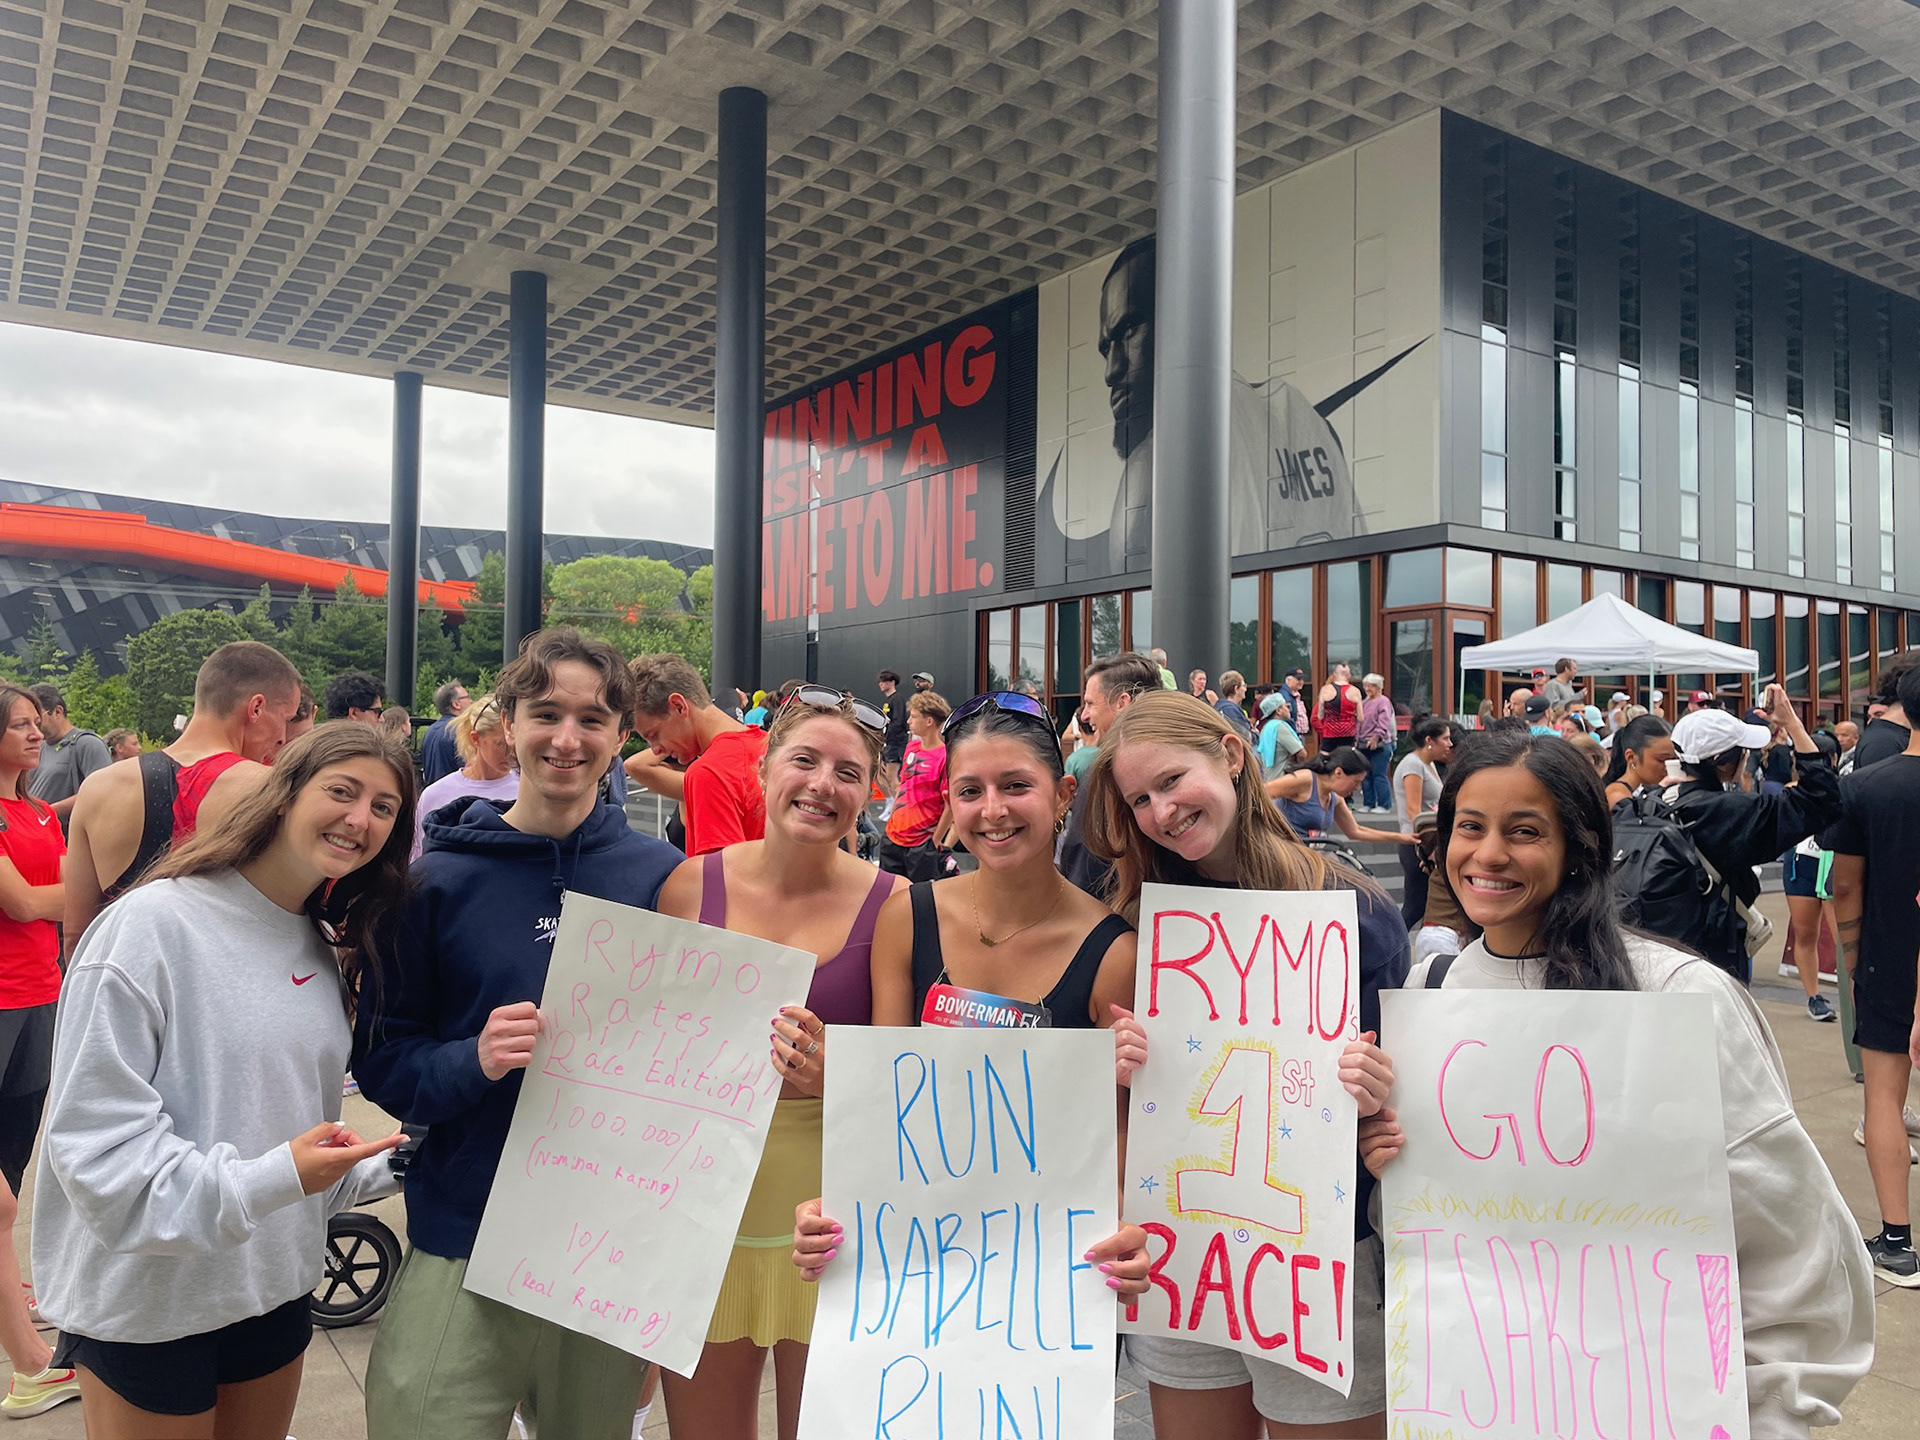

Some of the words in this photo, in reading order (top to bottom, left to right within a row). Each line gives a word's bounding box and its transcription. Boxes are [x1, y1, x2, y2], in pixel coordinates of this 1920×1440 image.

[900, 423, 949, 477] A
[841, 489, 894, 610] TO
[901, 463, 995, 600] ME.
[571, 982, 712, 1042] Rates
[935, 993, 1017, 1028] BOWERMAN
[1019, 1012, 1042, 1028] 5K
[544, 1029, 625, 1077] Race
[645, 1057, 756, 1113] Edition
[1438, 1038, 1596, 1167] GO
[506, 1257, 555, 1298] (Real
[566, 1222, 625, 1275] 10/10
[849, 1200, 1095, 1352] ISABELLE
[1123, 1222, 1345, 1379] RACE!
